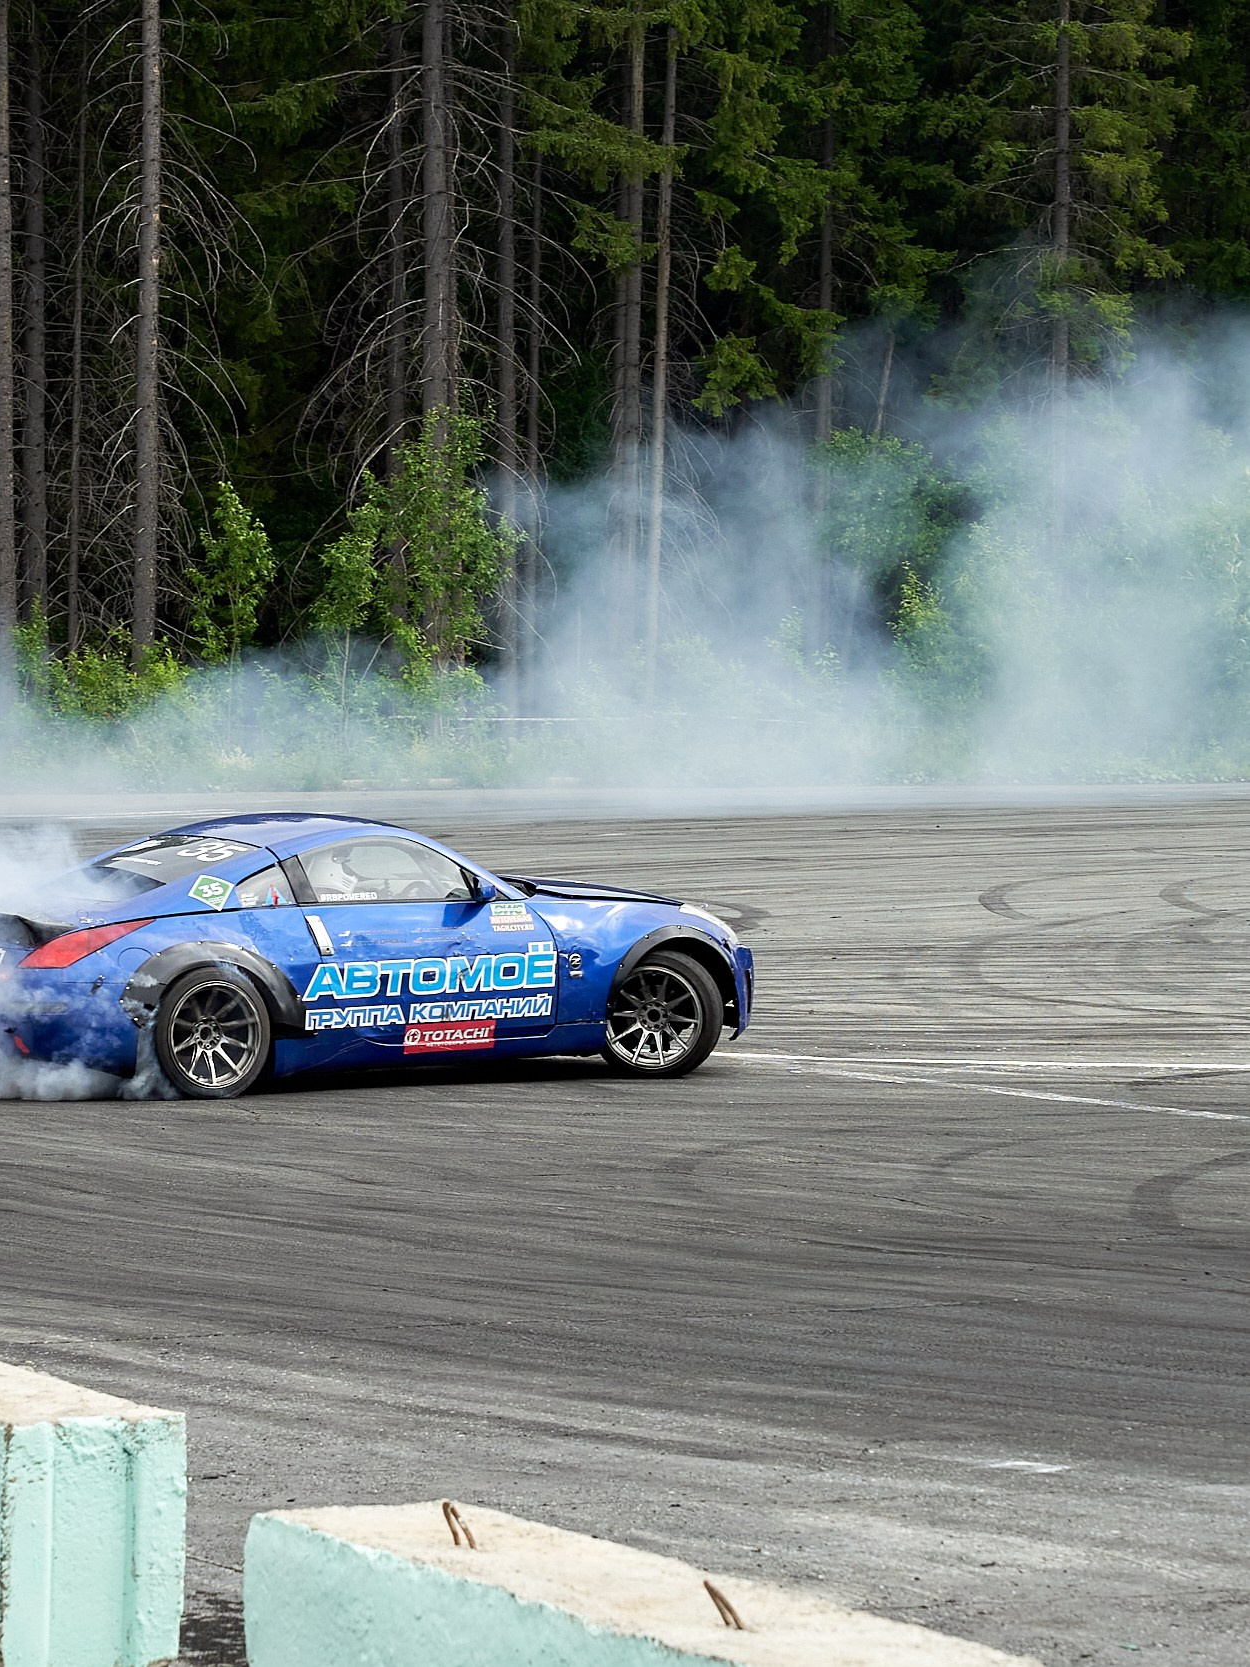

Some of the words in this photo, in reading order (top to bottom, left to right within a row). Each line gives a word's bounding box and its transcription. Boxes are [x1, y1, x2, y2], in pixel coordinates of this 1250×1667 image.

[176, 842, 248, 862] 35
[198, 882, 224, 898] 35
[302, 941, 556, 1002] АВТОМОЁ
[305, 1002, 406, 1031] ГРУППА
[408, 993, 552, 1023] КОМПАНИЙ
[422, 1026, 490, 1042] TOTACHI
